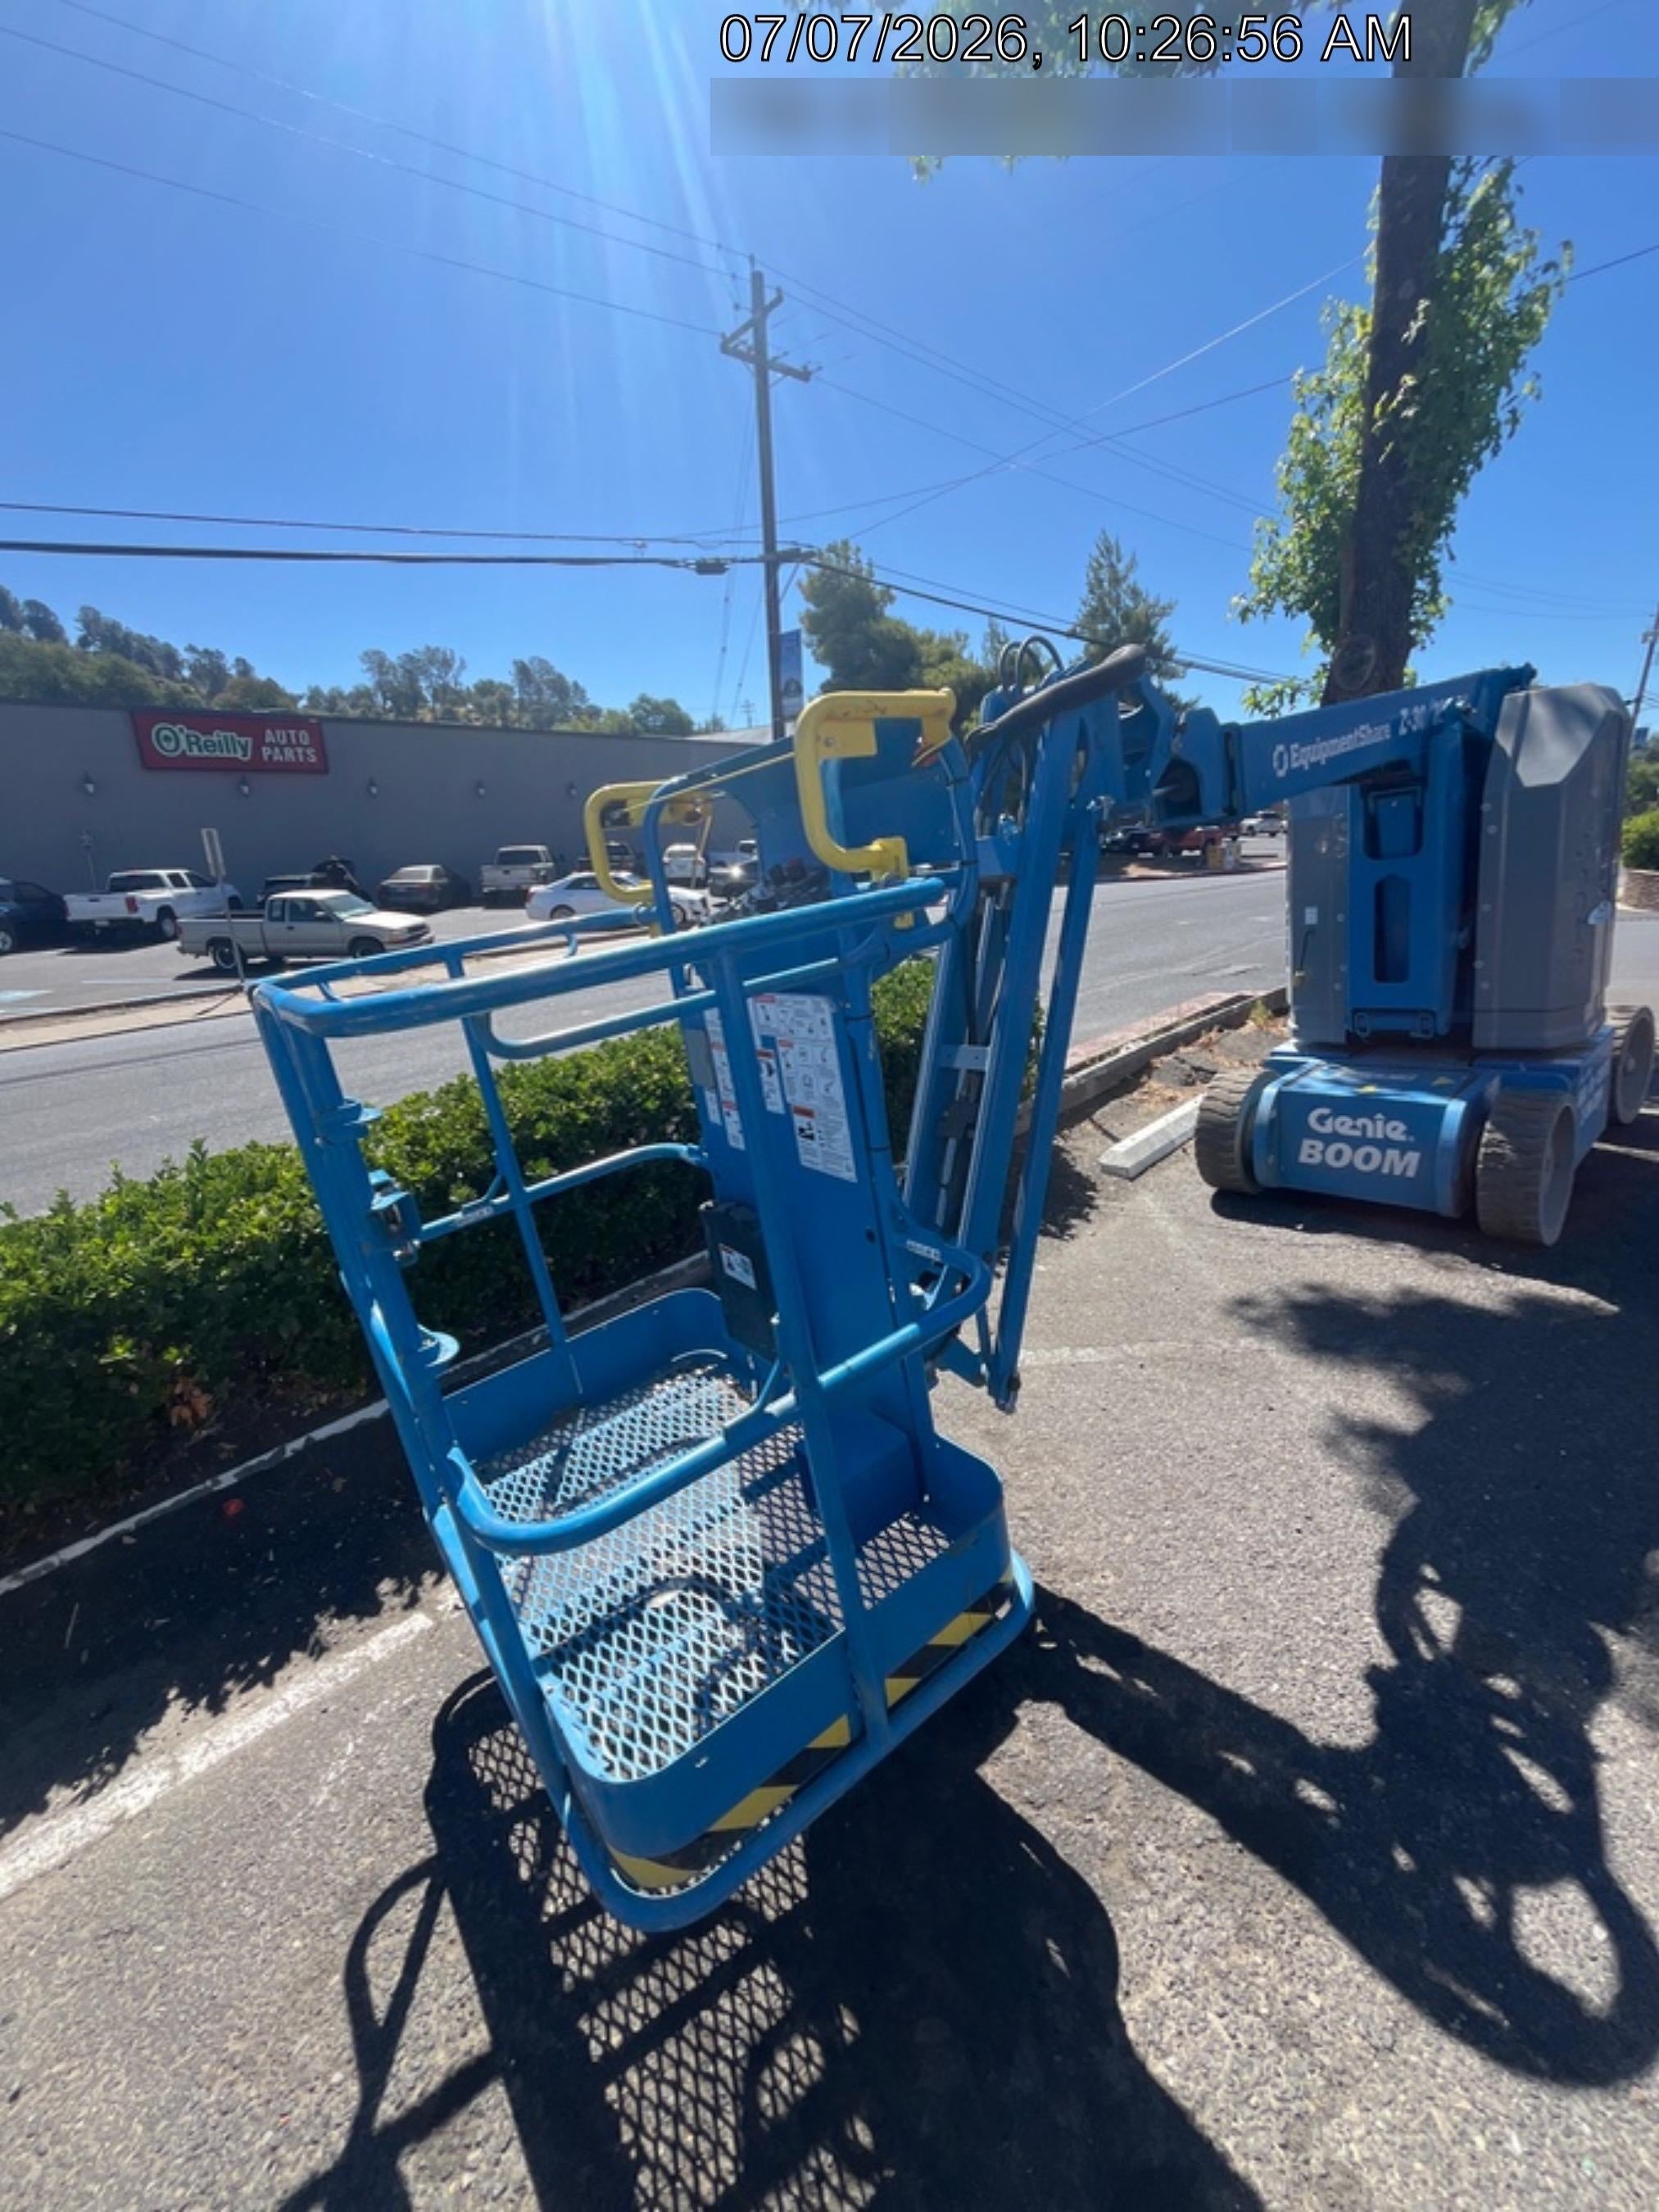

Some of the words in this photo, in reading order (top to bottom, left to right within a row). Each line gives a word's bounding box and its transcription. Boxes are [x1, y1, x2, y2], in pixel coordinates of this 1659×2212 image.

[152, 723, 252, 760] O'Reilly
[261, 746, 317, 763] PARTS
[264, 729, 310, 746] AUTO
[1290, 723, 1391, 770] EquipmentShare
[1308, 1107, 1408, 1141] Genie
[1298, 1138, 1421, 1178] BOOM
